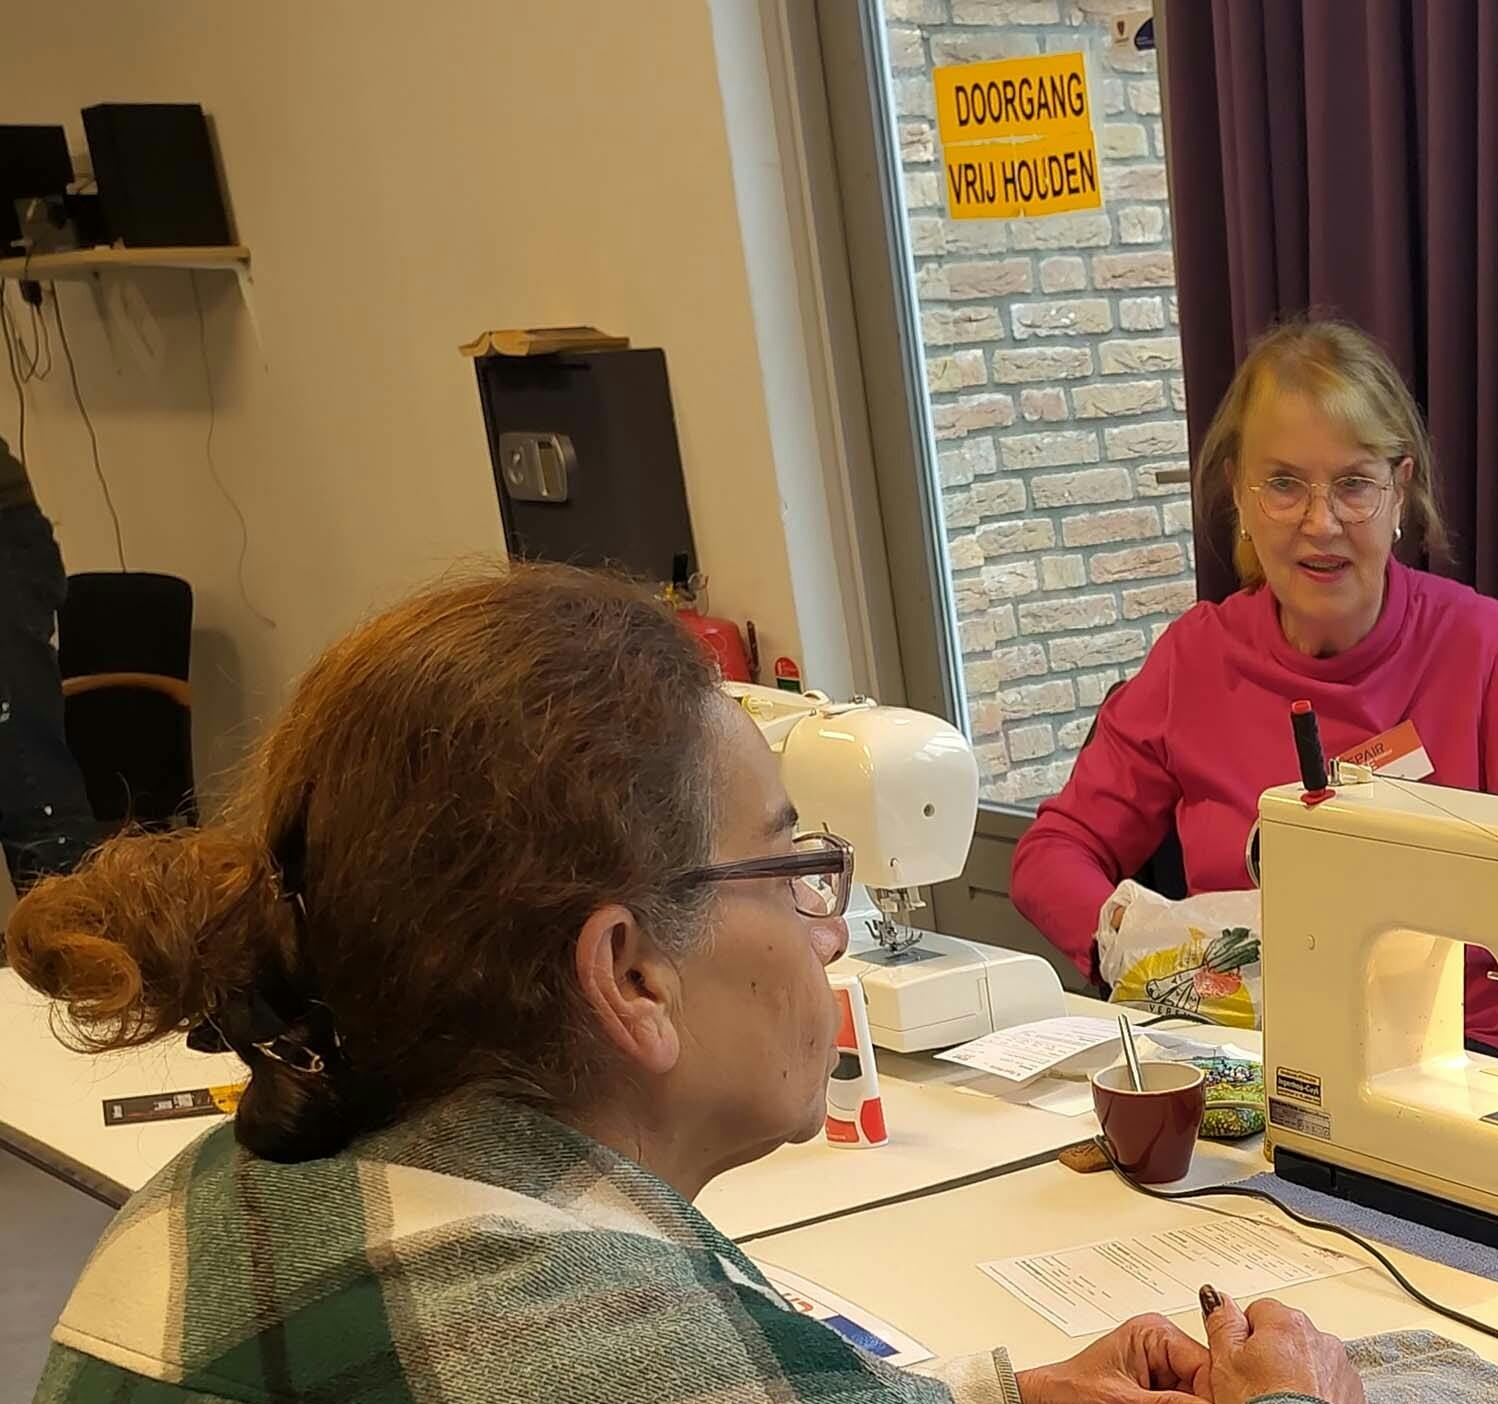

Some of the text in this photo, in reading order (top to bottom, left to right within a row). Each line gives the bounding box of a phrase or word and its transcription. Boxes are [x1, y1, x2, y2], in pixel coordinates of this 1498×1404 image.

[955, 72, 1084, 126] DOORGANG
[948, 149, 1096, 205] VRIJ HOUDEN
